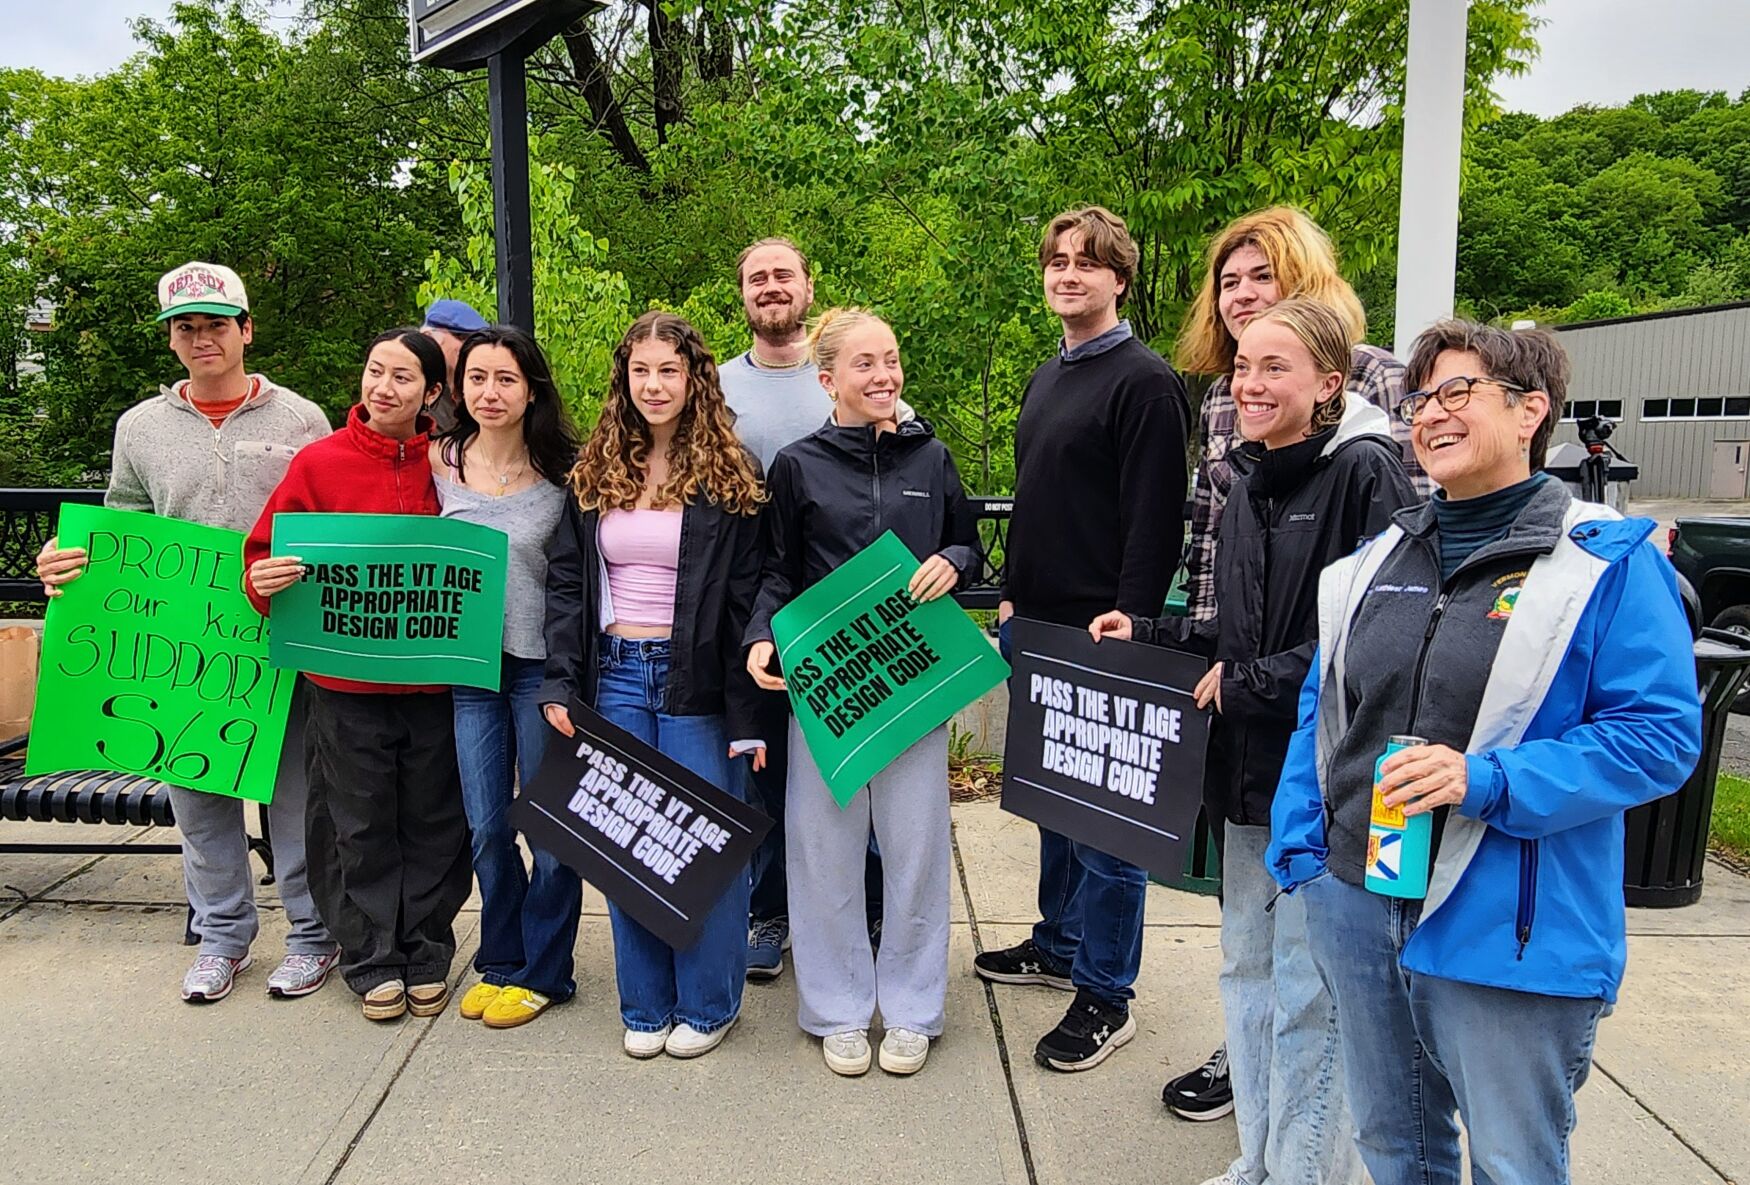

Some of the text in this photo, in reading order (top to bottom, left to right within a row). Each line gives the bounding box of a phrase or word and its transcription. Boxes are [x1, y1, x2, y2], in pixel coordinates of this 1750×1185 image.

[168, 274, 193, 305] RED
[198, 273, 228, 300] SOX
[85, 531, 247, 595] PROTE
[301, 563, 483, 593] PASS THE VT AGE
[201, 601, 271, 643] kid
[320, 586, 463, 615] APPROPRIATE
[322, 611, 459, 640] DESIGN CODE
[814, 627, 859, 667] THE
[848, 612, 880, 648] VT
[873, 588, 920, 627] AGE
[58, 624, 280, 714] SUPPORT
[805, 620, 924, 719] APPROPRIATE
[823, 641, 941, 739] DESIGN CODE
[96, 693, 258, 792] S.69
[1030, 673, 1182, 743] PASS THE VT AGE
[1043, 708, 1163, 772] APPROPRIATE
[575, 742, 732, 854] PASS THE VT AGE
[1042, 739, 1158, 805] DESIGN CODE
[567, 788, 686, 885] DESIGN CODE
[579, 769, 702, 864] APPROPRIATE
